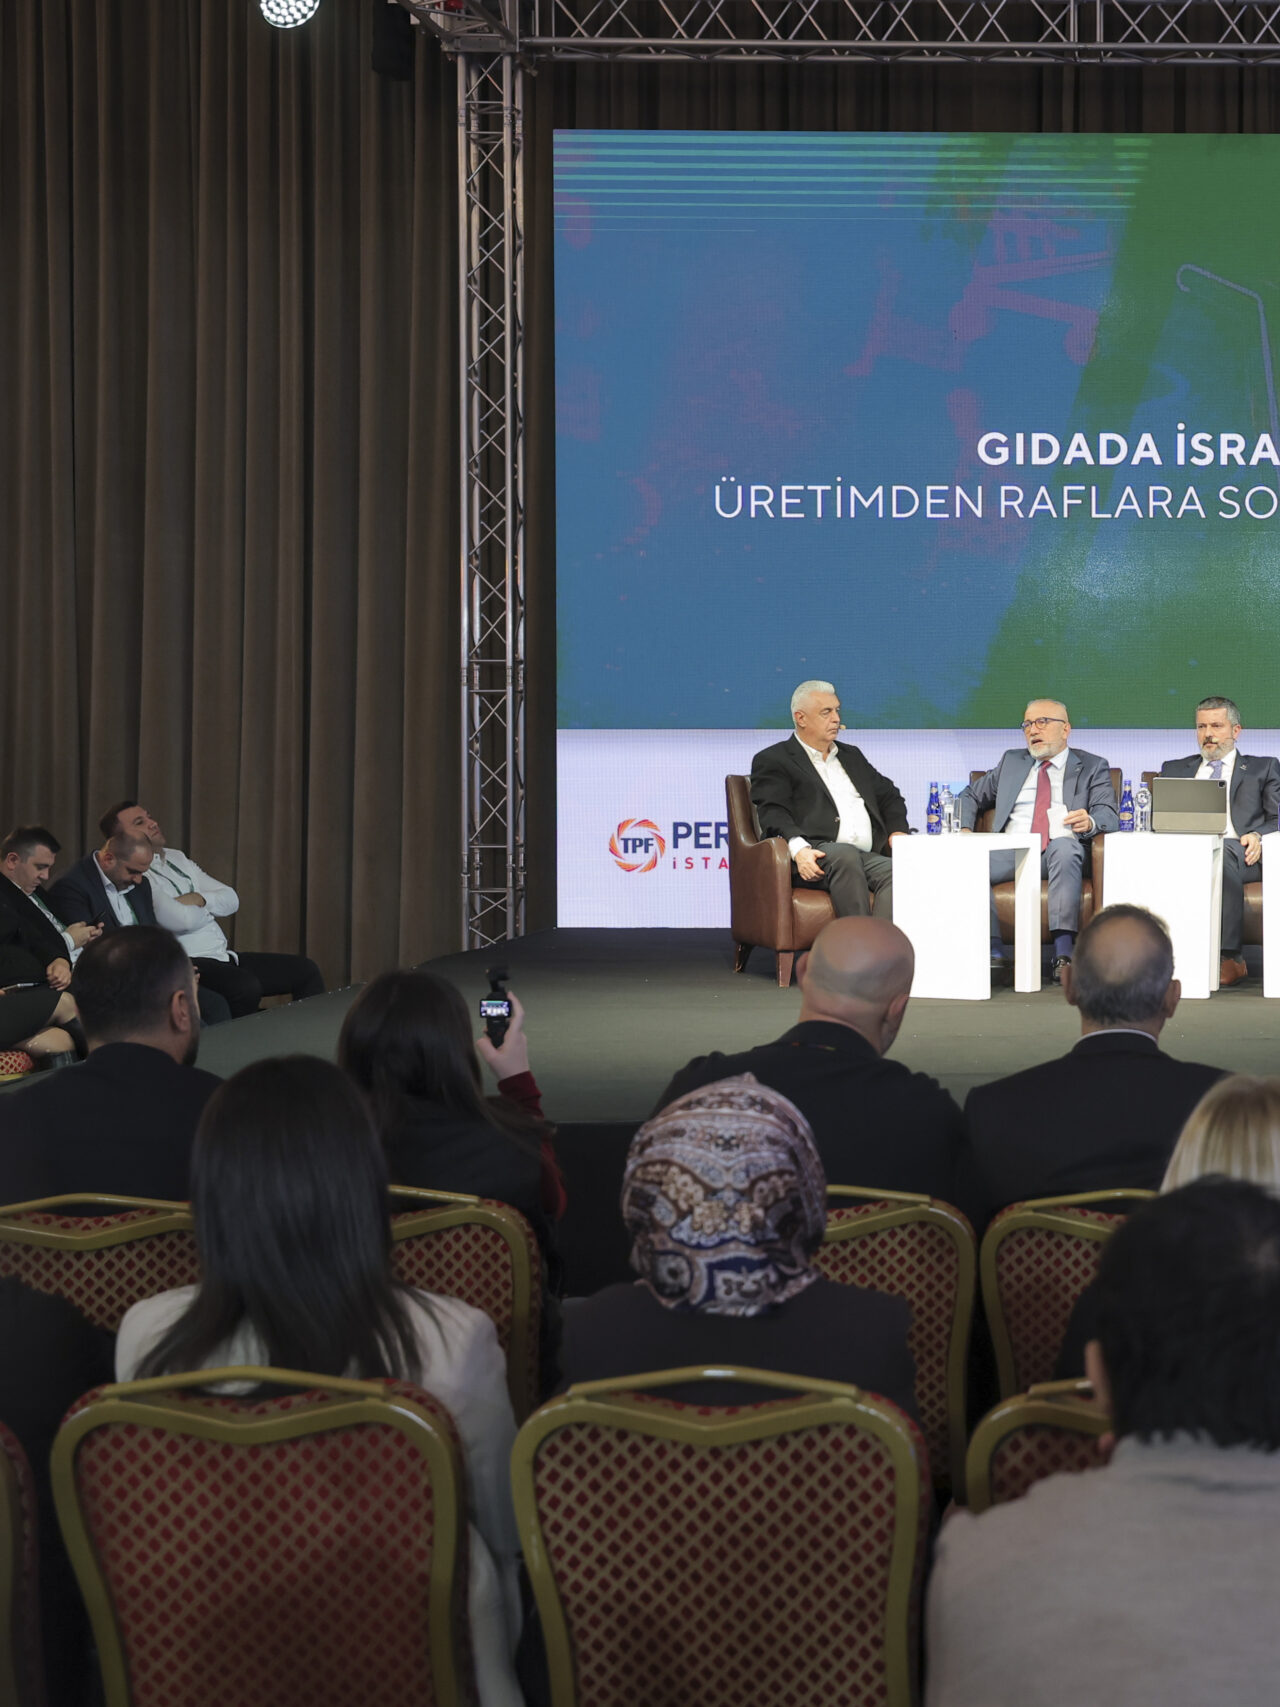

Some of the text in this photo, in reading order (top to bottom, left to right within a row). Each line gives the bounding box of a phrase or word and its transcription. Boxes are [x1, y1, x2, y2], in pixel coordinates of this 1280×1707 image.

[977, 431, 1163, 466] GIDADA
[714, 476, 983, 519] ÜRETİMDEN
[1000, 485, 1207, 519] RAFLARA
[620, 837, 654, 854] TPF
[672, 821, 729, 849] PER
